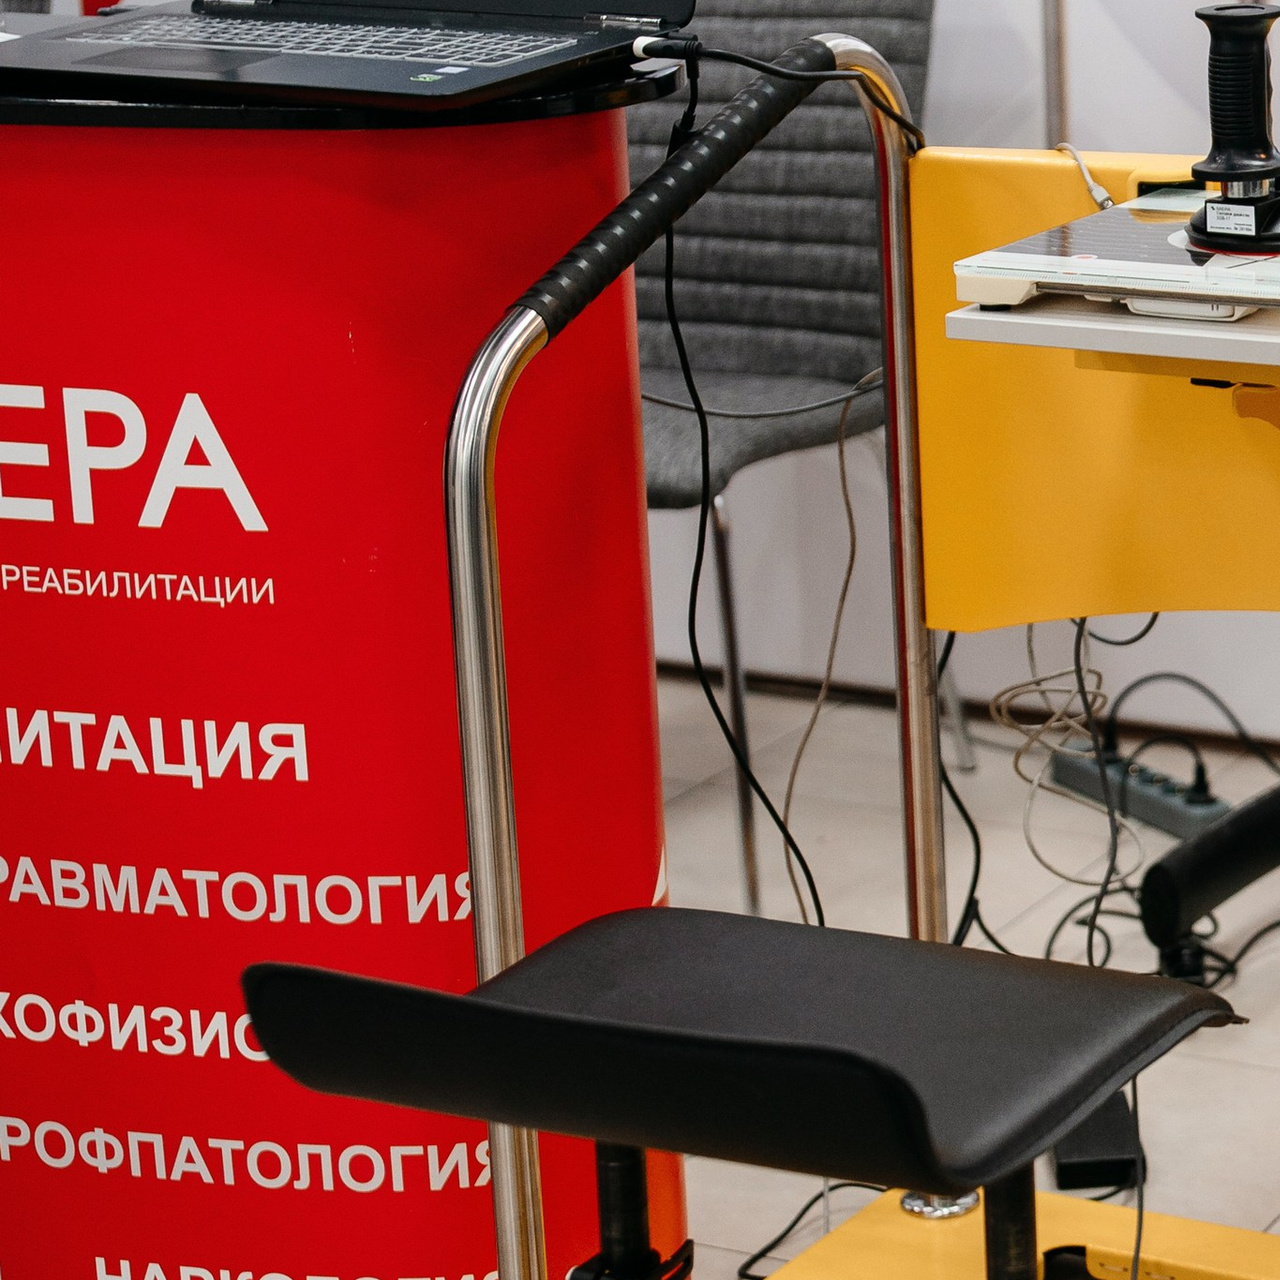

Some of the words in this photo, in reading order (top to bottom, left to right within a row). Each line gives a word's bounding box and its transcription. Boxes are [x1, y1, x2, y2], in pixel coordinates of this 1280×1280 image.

[1, 564, 275, 608] РЕАБИЛИТАЦИИ
[0, 707, 309, 790] ИТАЦИЯ
[0, 854, 472, 924] АВМАТОЛОГИ
